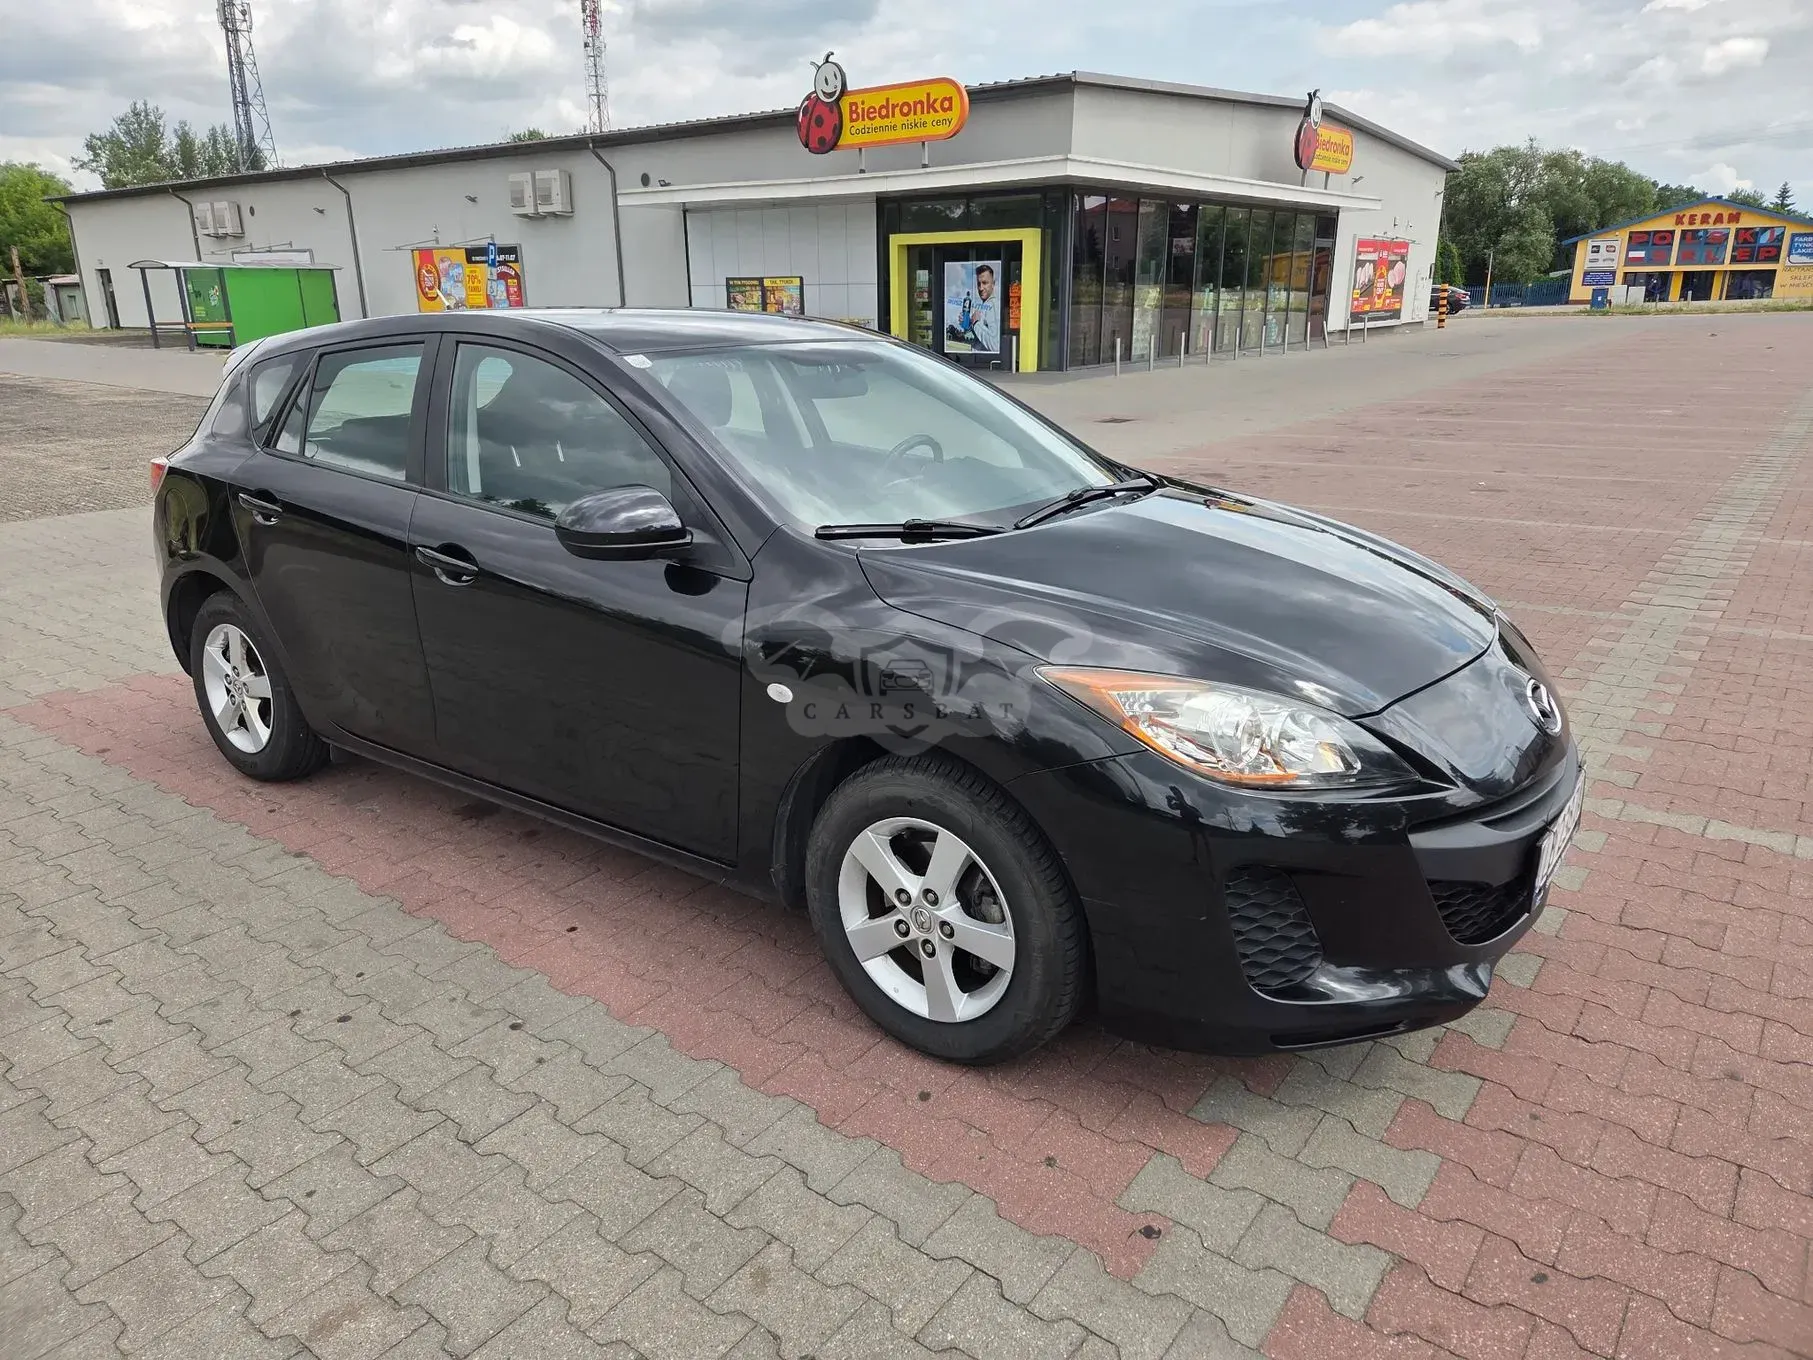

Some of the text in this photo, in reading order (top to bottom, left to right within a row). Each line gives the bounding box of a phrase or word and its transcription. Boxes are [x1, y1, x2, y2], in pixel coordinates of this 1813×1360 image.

[849, 92, 953, 122] Biedronka
[849, 116, 953, 136] Codziennie niskie ceny
[1675, 211, 1741, 226] KERAM
[489, 245, 495, 263] P
